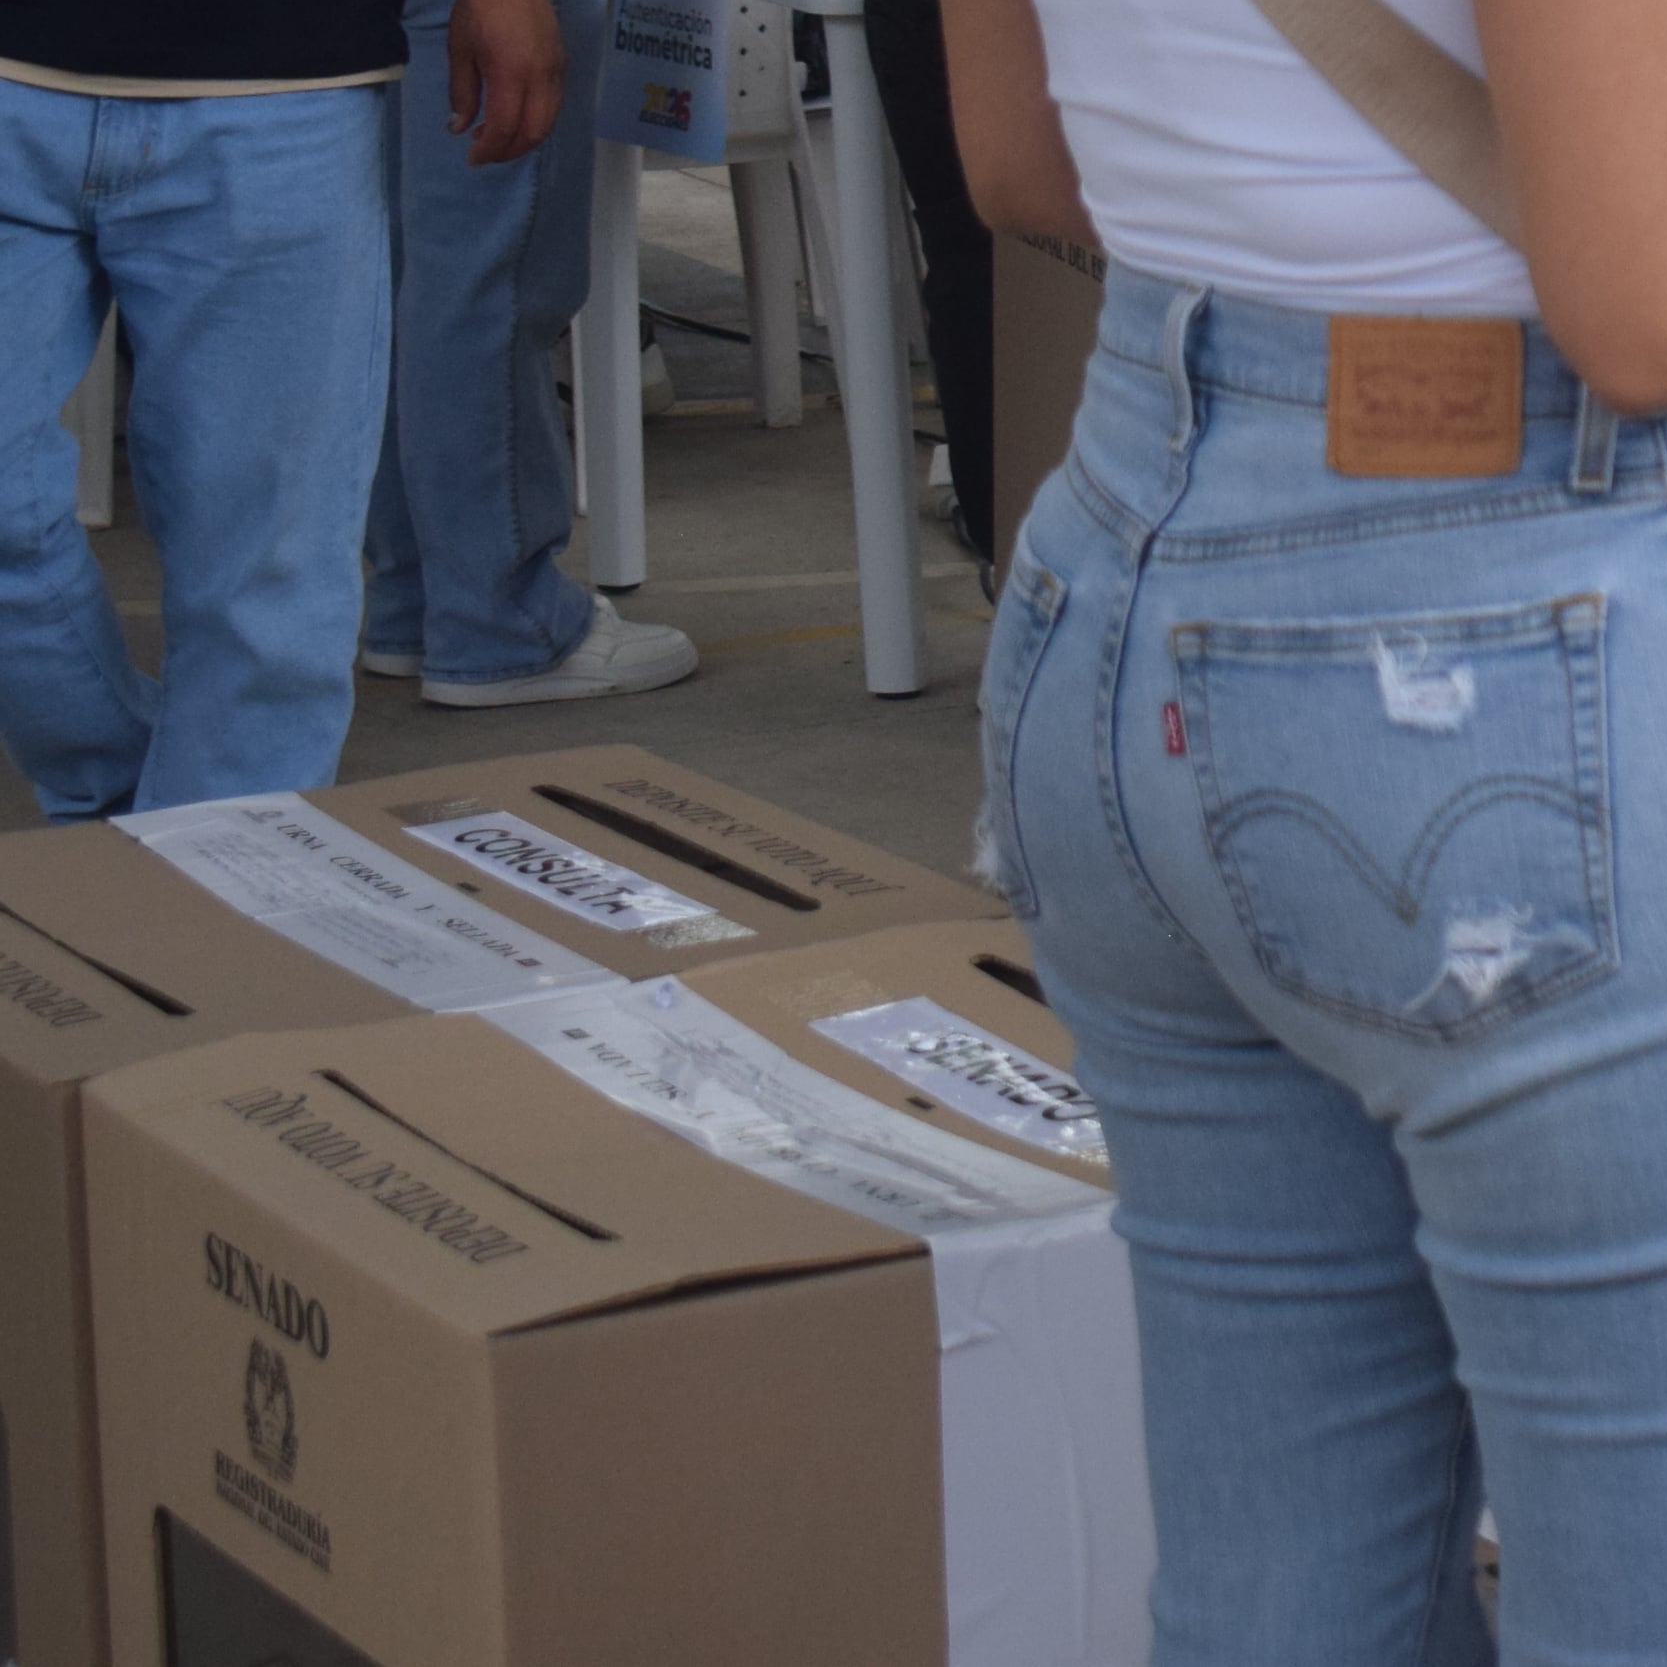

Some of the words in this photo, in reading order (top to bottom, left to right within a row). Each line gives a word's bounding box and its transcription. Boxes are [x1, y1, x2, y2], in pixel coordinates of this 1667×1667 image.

[615, 21, 712, 70] biométrica
[277, 823, 328, 851] URNA
[329, 855, 412, 900] CERRADA
[454, 828, 635, 915] CONSULTA
[373, 1181, 530, 1265] DEPOSITE
[206, 1232, 330, 1360] SENADO
